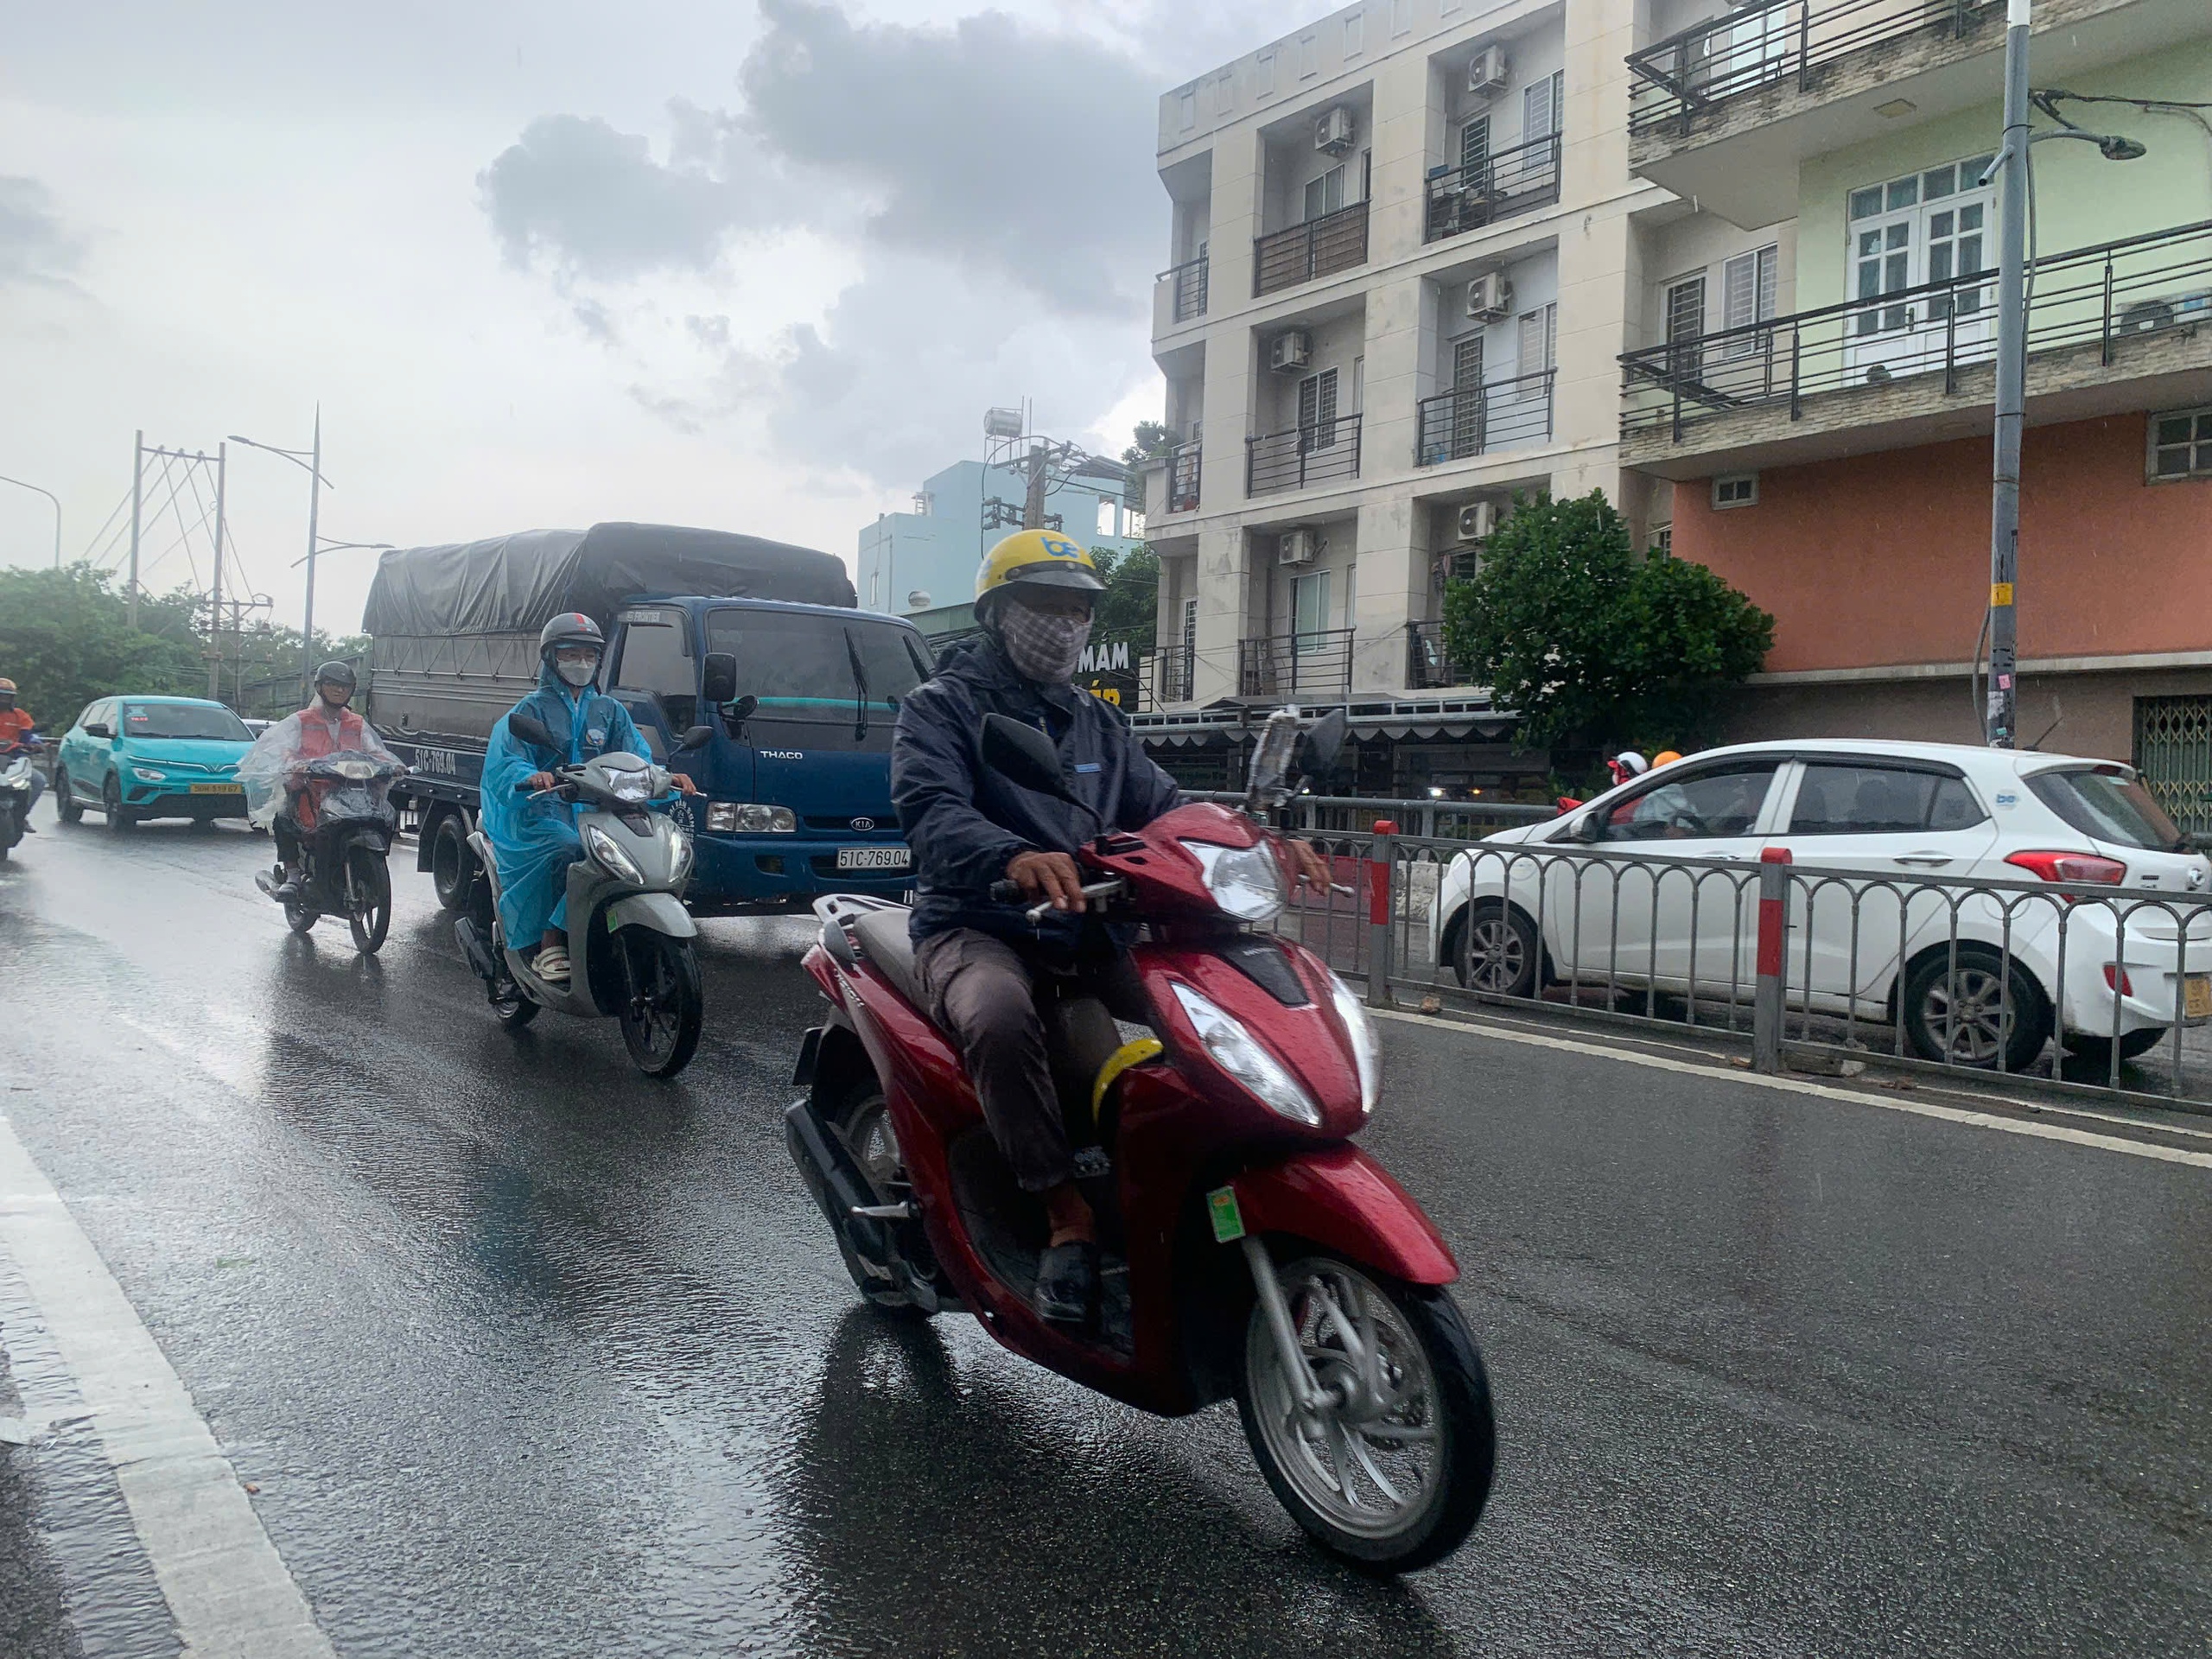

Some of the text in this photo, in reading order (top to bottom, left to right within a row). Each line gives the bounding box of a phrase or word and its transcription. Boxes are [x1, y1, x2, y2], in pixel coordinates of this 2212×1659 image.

[1039, 537, 1079, 559] be
[1077, 632, 1129, 673] MẮM
[760, 750, 804, 760] THACO
[840, 850, 908, 867] 51C-769.04
